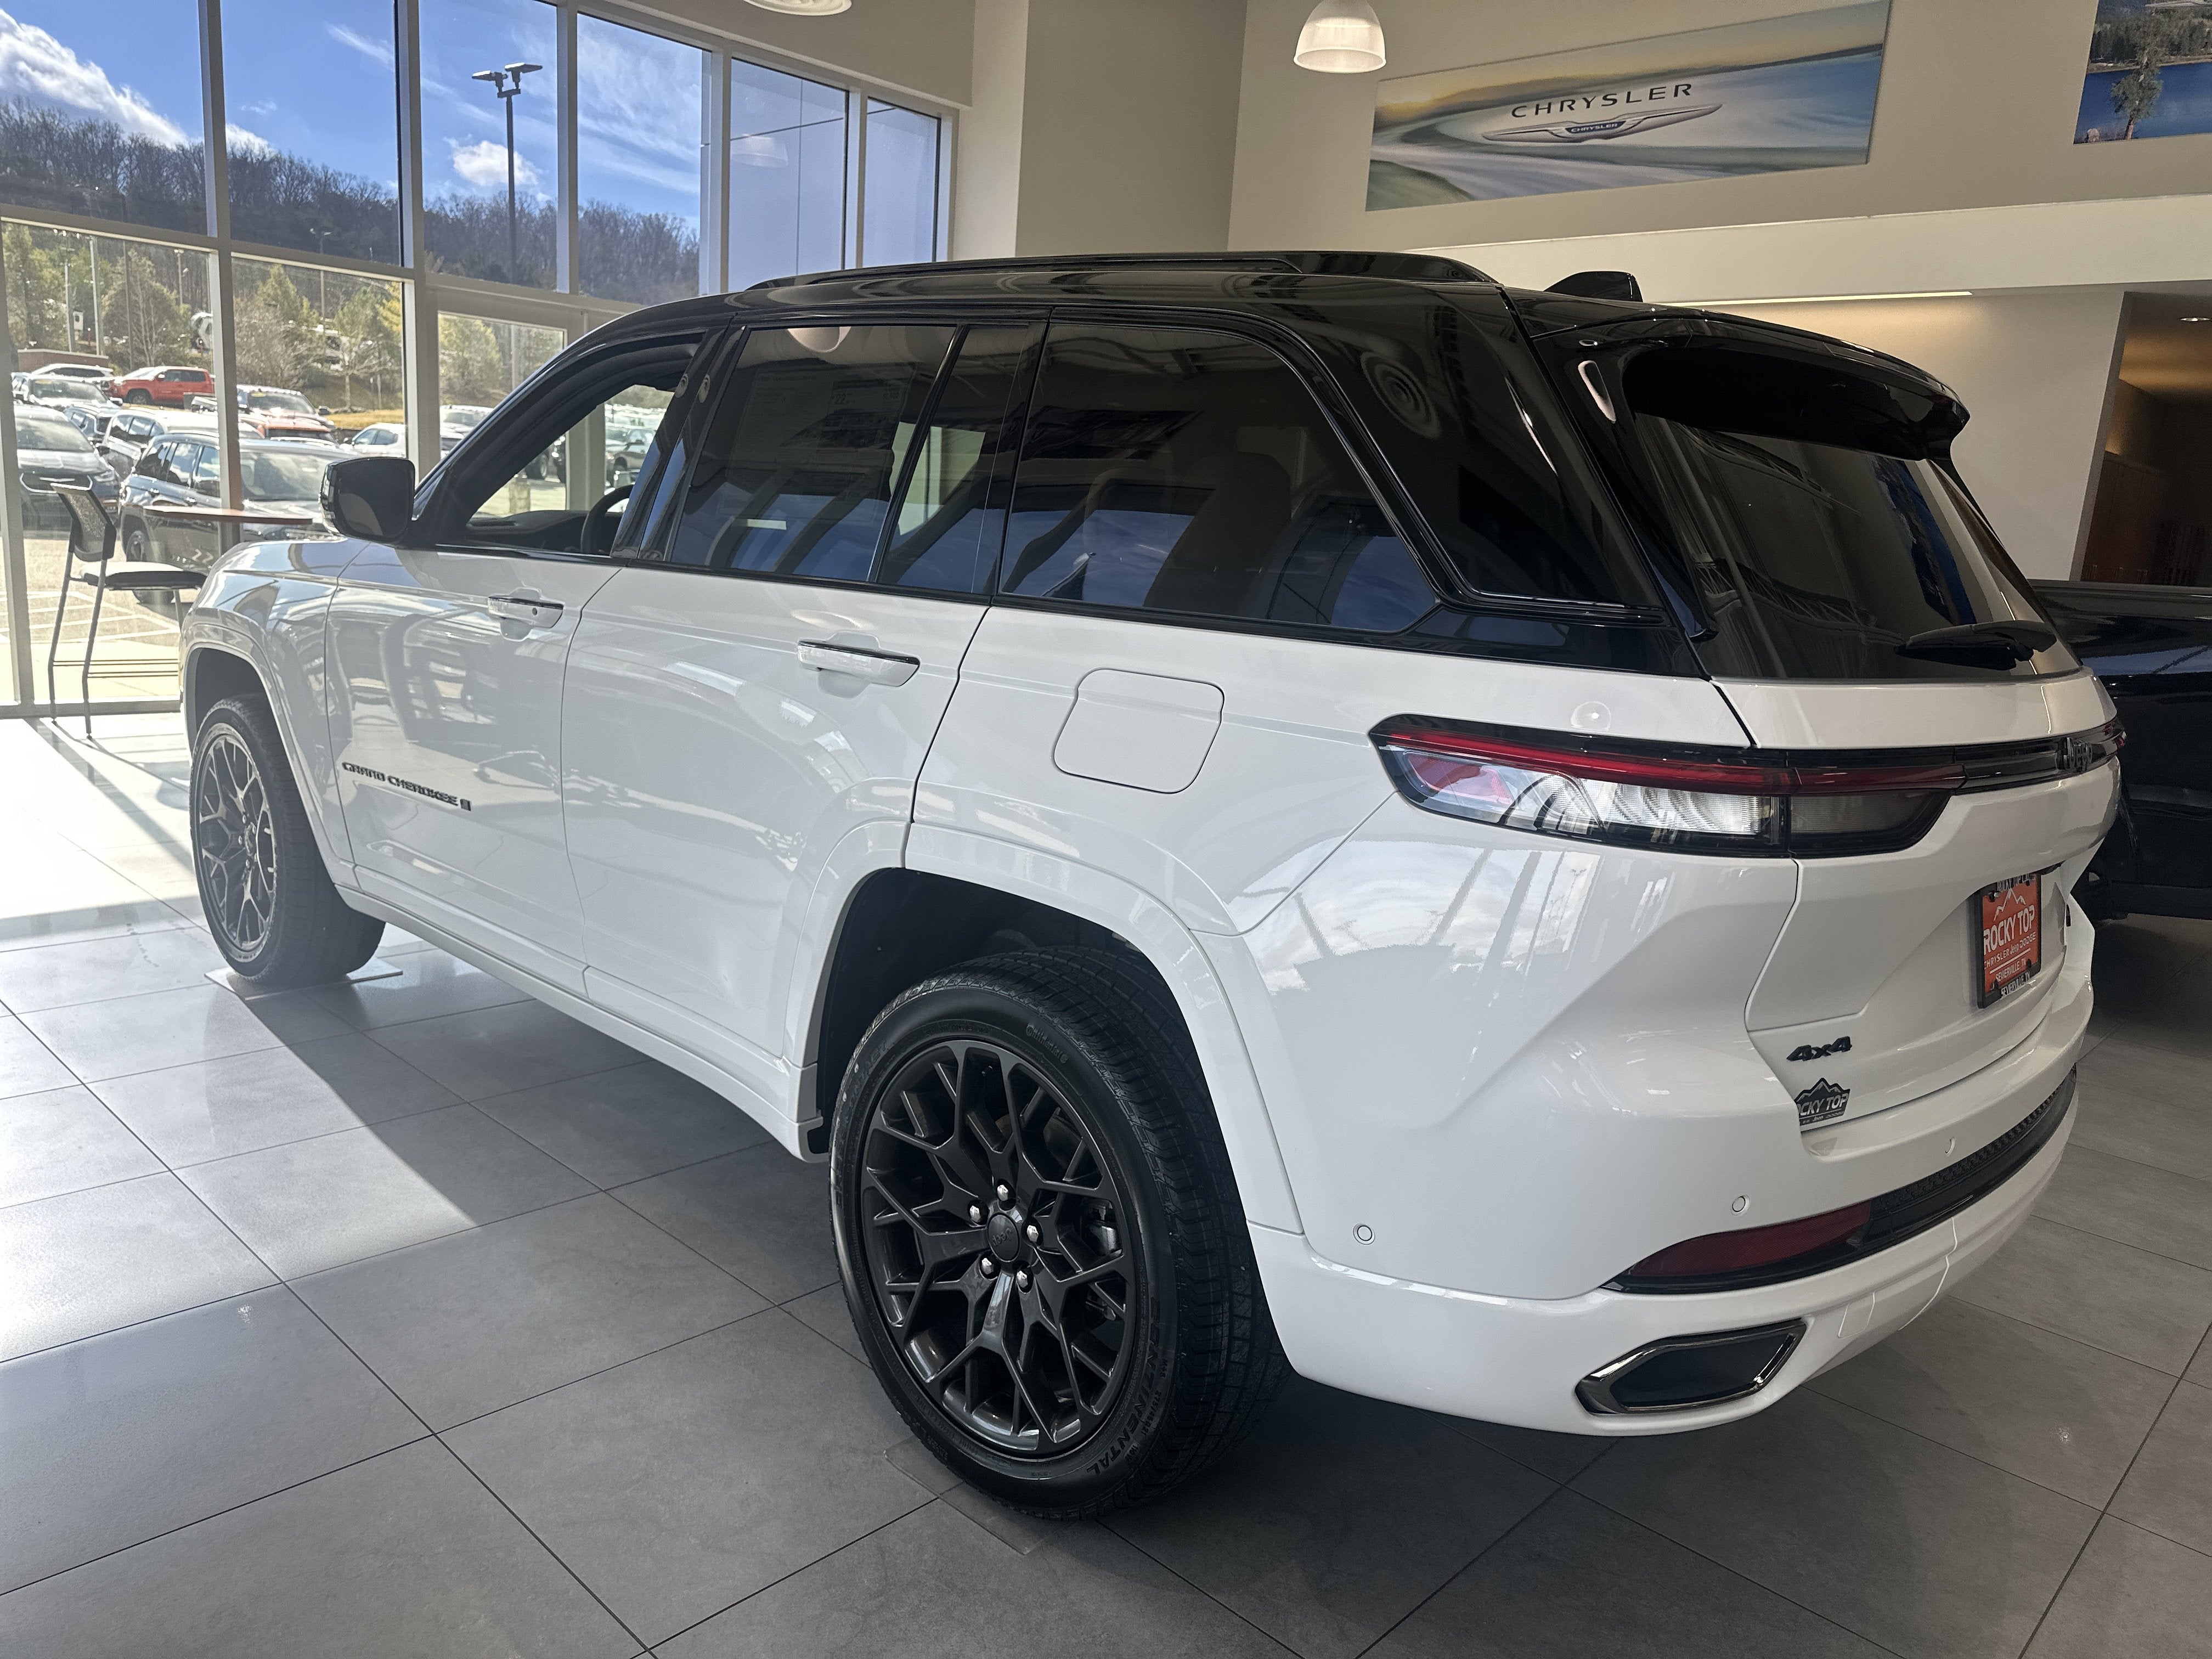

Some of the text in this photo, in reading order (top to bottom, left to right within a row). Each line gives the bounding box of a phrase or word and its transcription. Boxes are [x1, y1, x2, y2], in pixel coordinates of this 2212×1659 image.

[1511, 83, 1691, 117] CHRYSLER
[1571, 122, 1618, 133] CHRYSLER
[342, 761, 459, 806] GRAND CHEROKEE
[1983, 904, 2035, 956] ROCKY TOP
[1984, 948, 2010, 970] CHRYSLER
[1825, 1093, 1849, 1111] TOP
